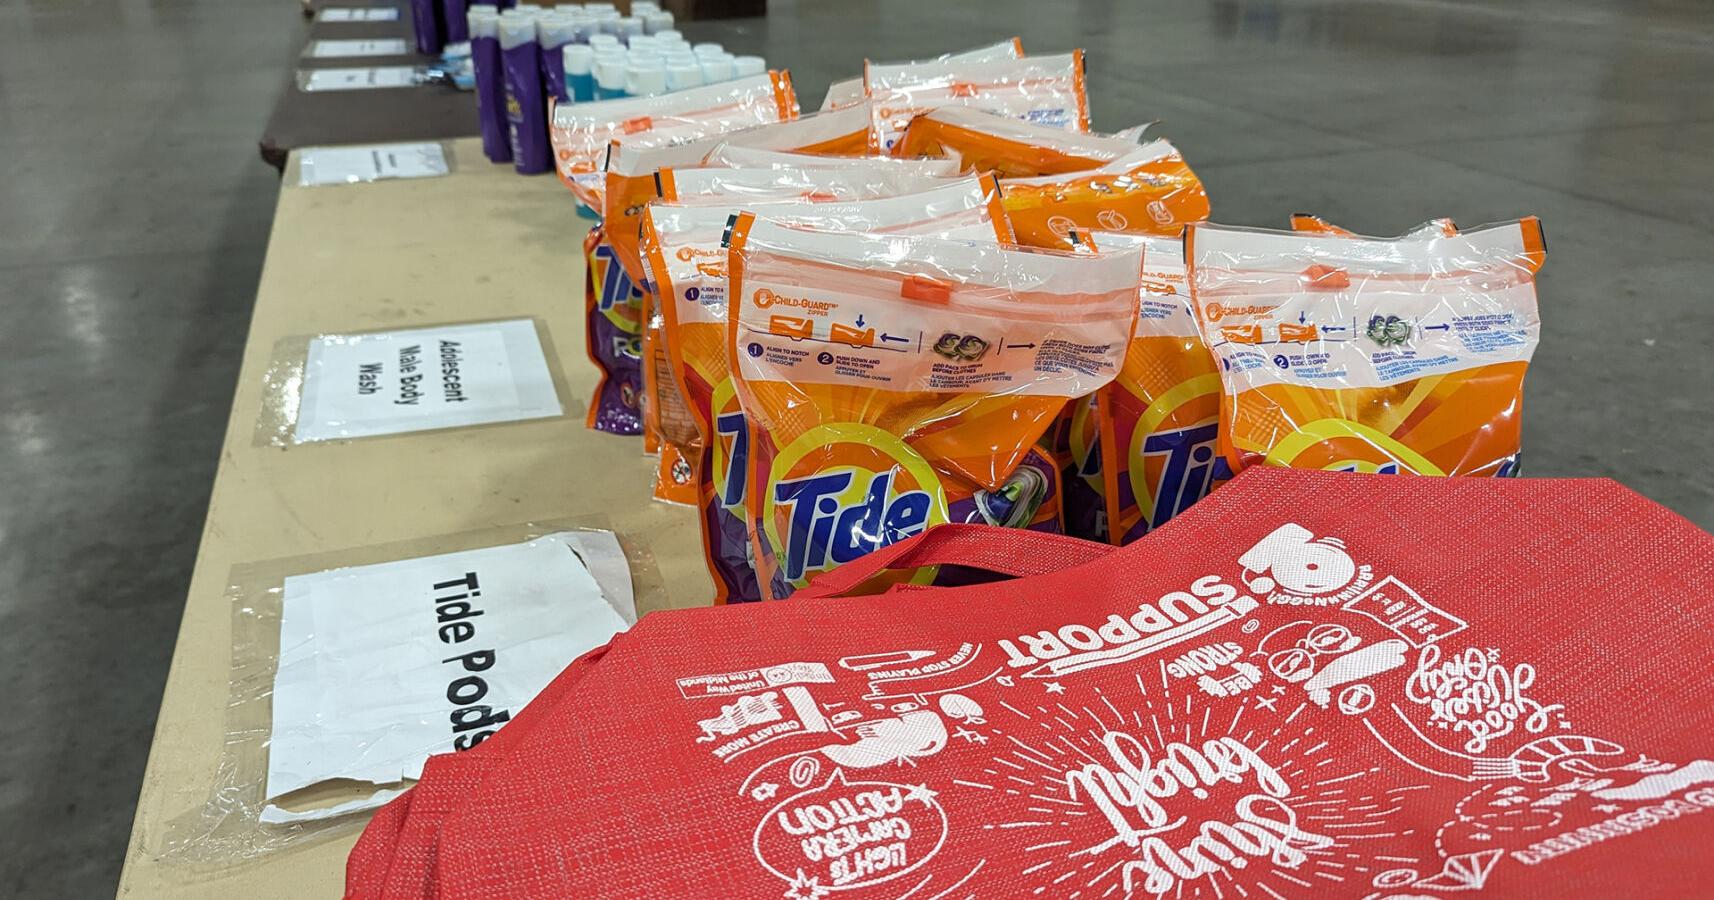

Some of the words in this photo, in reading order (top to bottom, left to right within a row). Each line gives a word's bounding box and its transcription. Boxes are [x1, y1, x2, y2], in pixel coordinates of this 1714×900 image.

[596, 243, 648, 312] Ti
[398, 344, 421, 374] Male
[766, 346, 783, 355] ALIGN
[766, 353, 789, 361] ALIGNER
[851, 356, 868, 364] DOWN
[357, 362, 384, 396] Wash
[439, 340, 469, 403] Adolescent
[393, 373, 425, 406] Body
[1142, 423, 1219, 533] Ti
[774, 463, 934, 583] Tide
[433, 572, 485, 644] Tide
[998, 574, 1238, 668] SUPPORT
[921, 659, 951, 674] STOP
[947, 641, 974, 664] NEVER
[1166, 641, 1245, 679] STRONG
[679, 675, 731, 687] Midlands
[706, 681, 730, 695] Way
[729, 680, 766, 694] United
[730, 671, 747, 683] the
[747, 670, 760, 681] of
[867, 667, 922, 680] PLAYING
[1222, 675, 1254, 698] BE
[442, 648, 511, 752] Pods
[1453, 662, 1566, 754] Good
[1064, 731, 1291, 857] bright
[777, 786, 905, 836] ACTION
[800, 816, 912, 862] CAMERA
